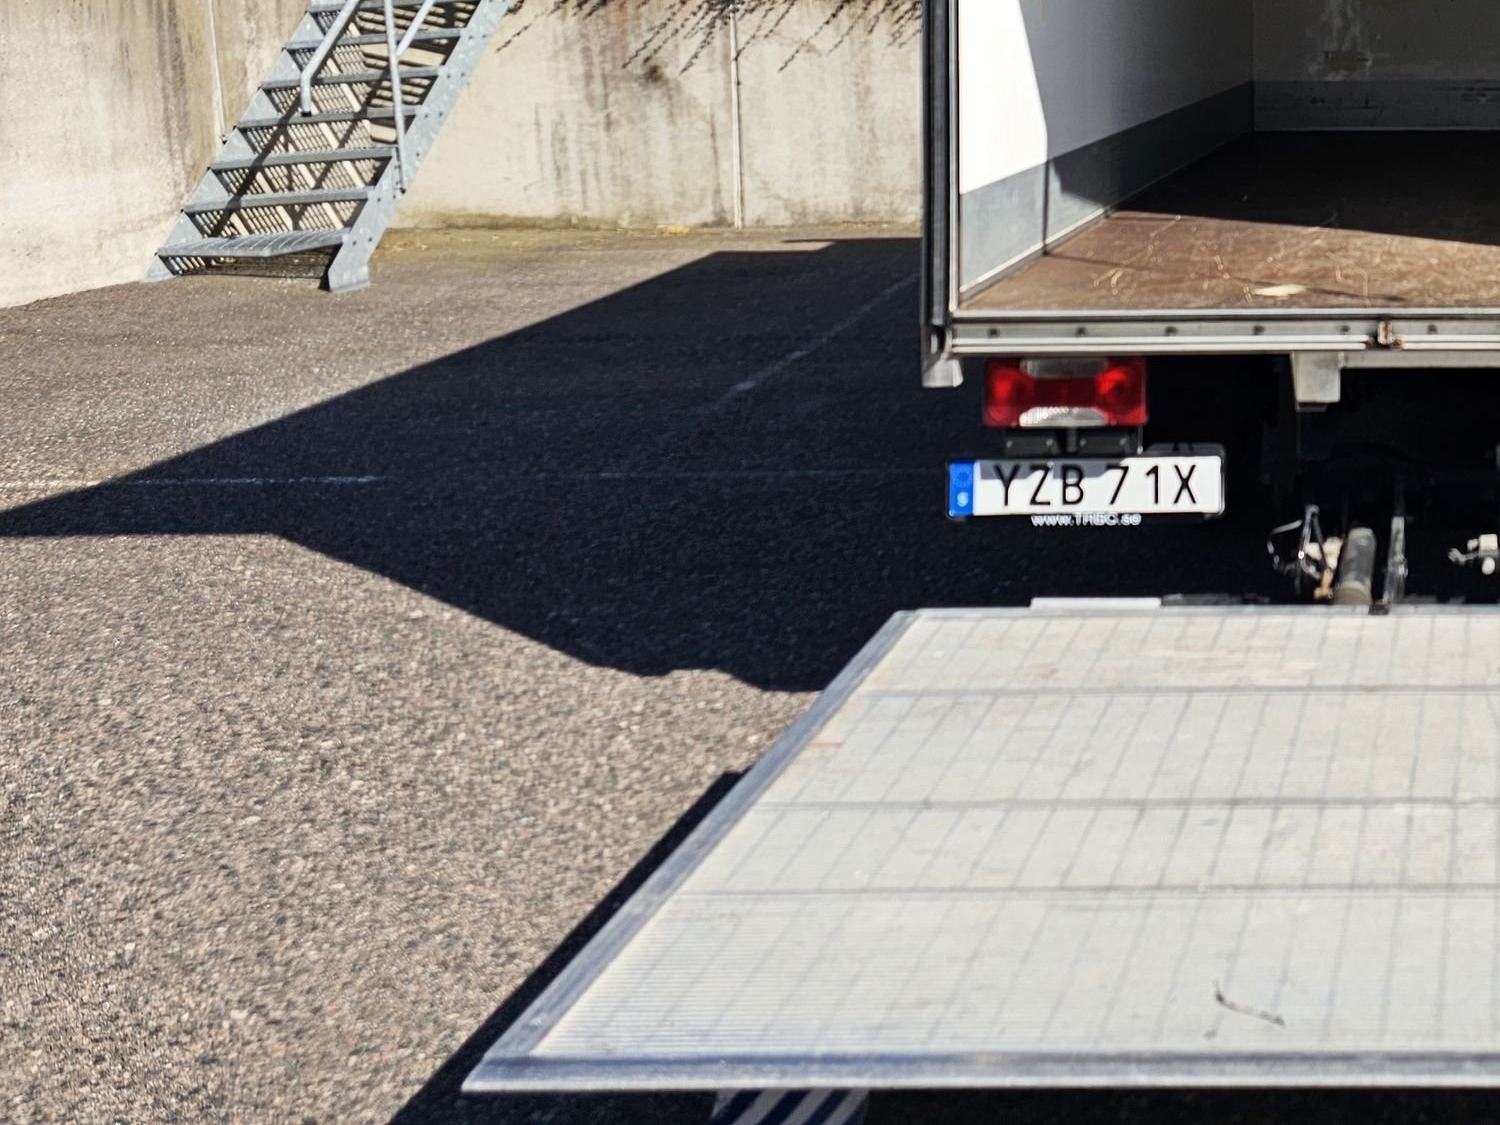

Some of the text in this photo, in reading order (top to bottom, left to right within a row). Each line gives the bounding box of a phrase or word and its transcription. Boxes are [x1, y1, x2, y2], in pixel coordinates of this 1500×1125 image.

[956, 491, 969, 507] S
[993, 465, 1196, 506] YZB 71X
